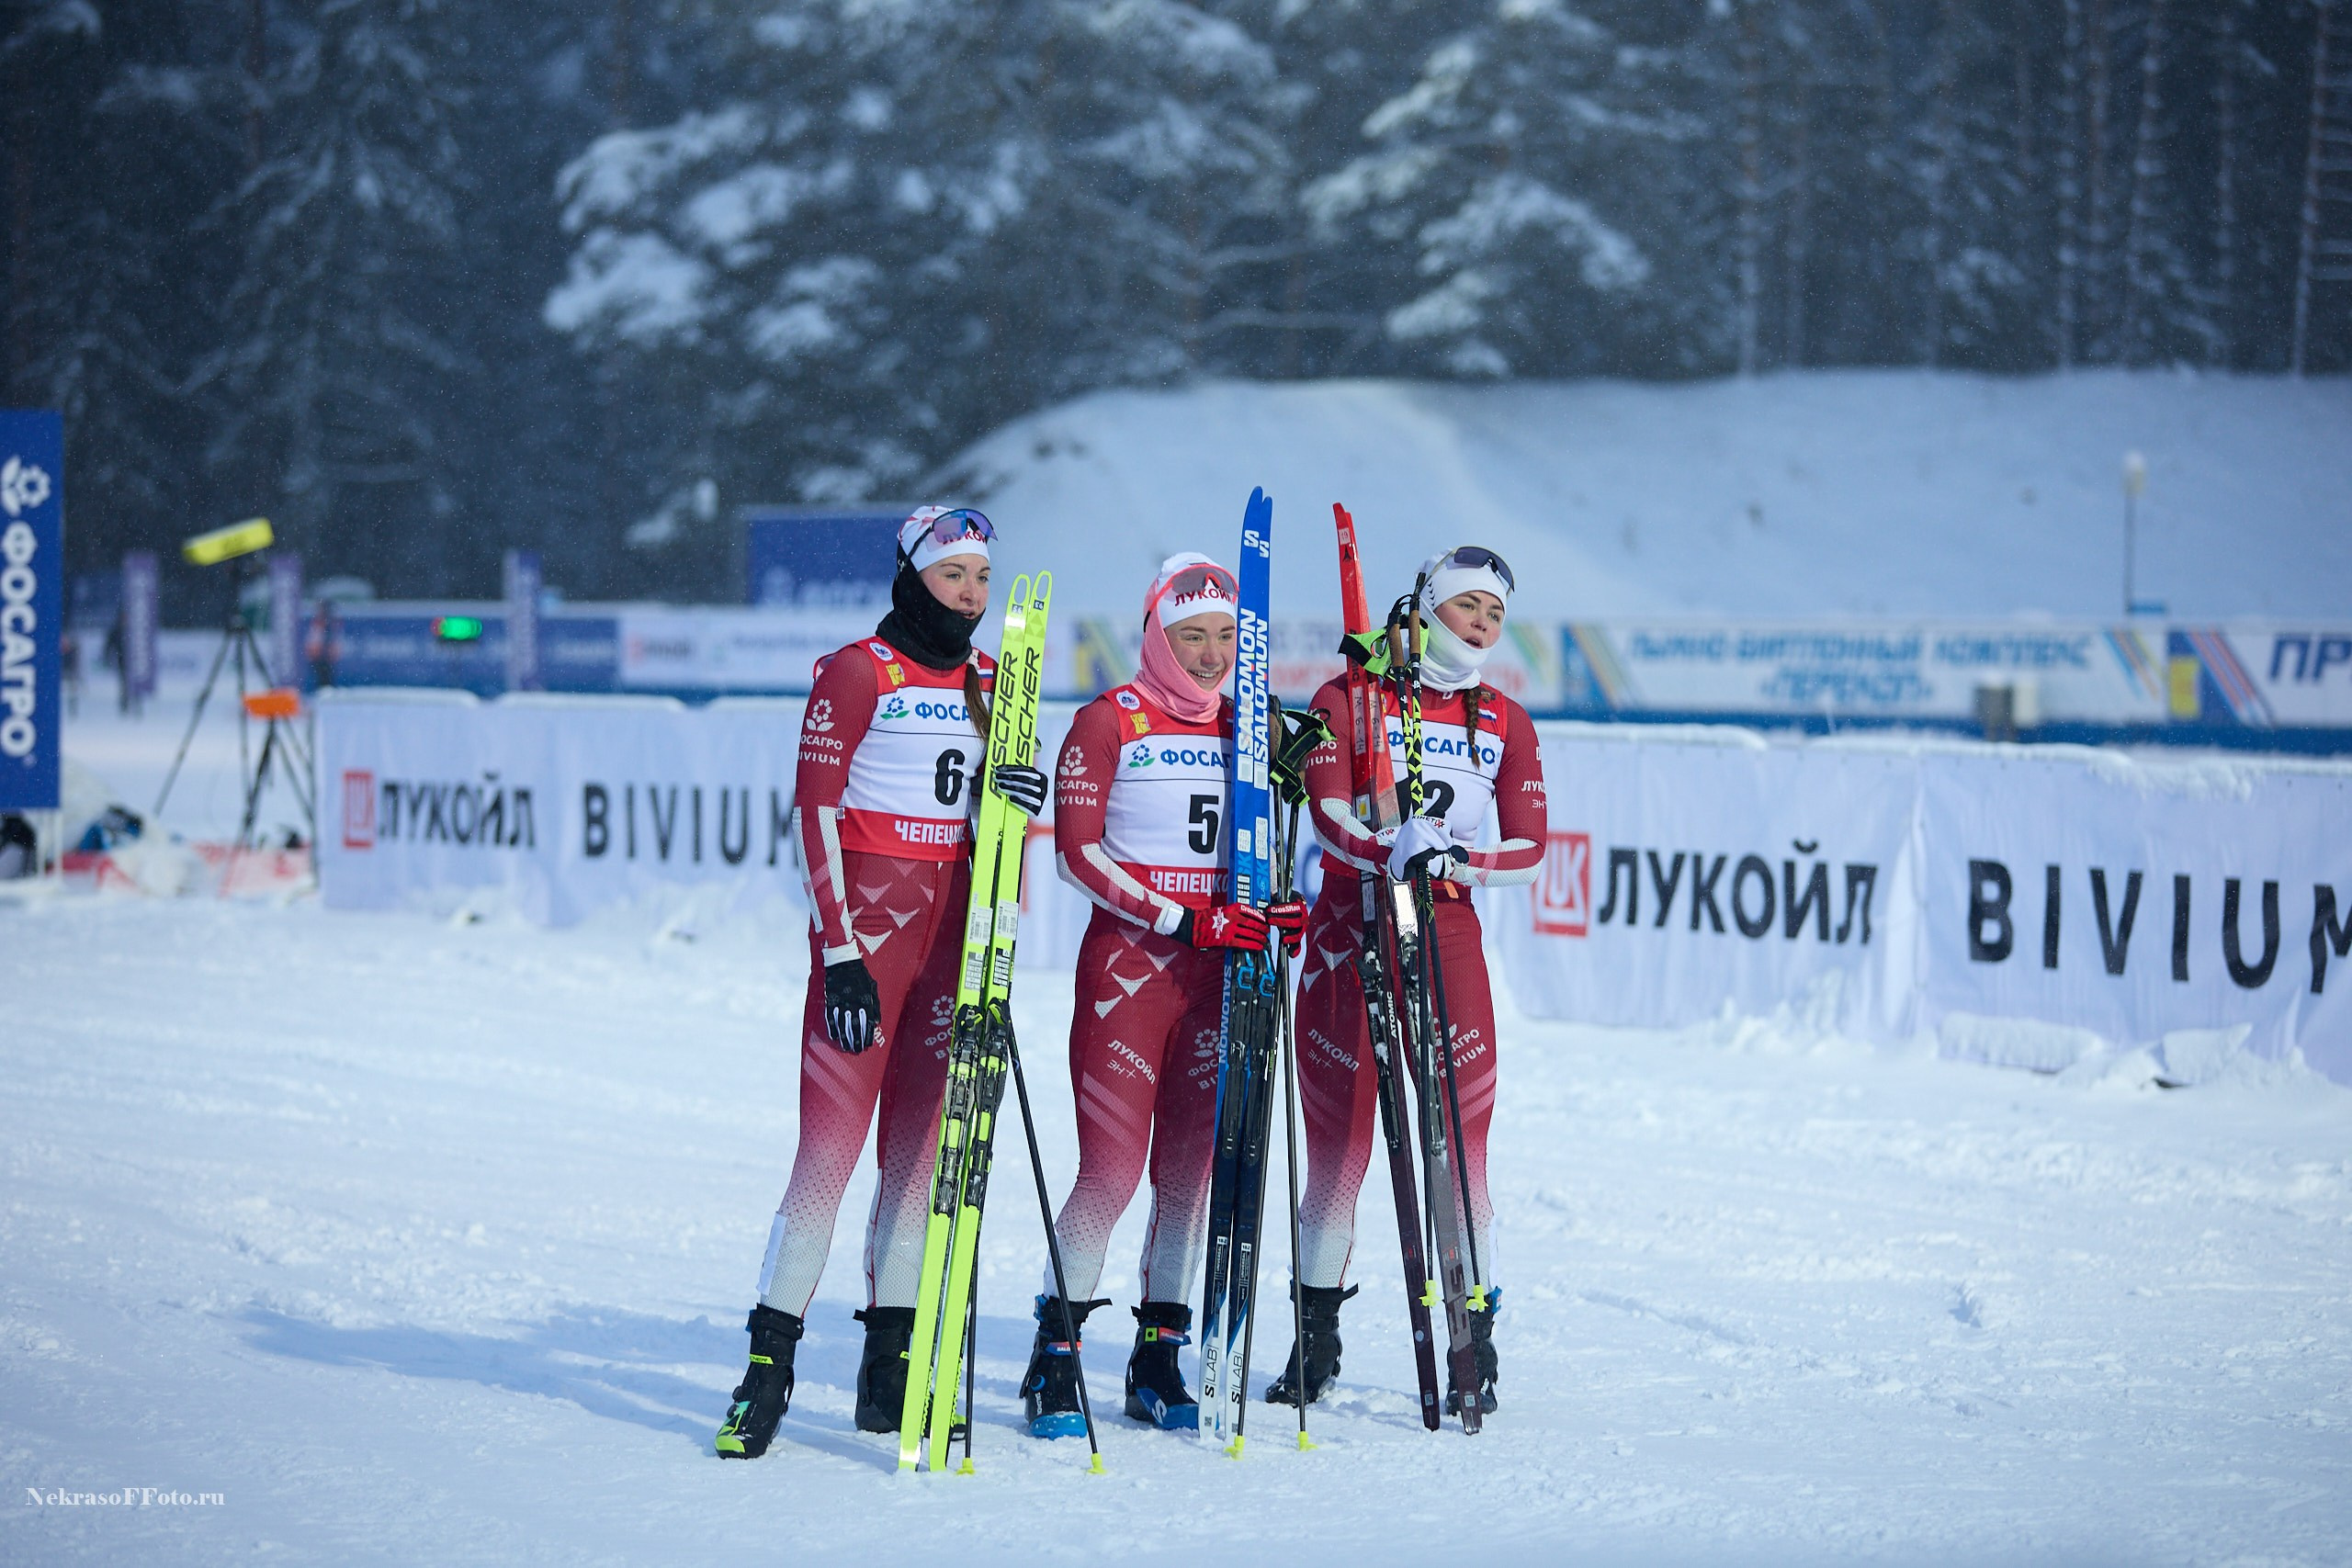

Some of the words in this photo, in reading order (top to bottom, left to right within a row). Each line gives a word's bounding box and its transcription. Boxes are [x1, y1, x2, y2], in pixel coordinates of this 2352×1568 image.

[0, 521, 38, 757] ФОСАГРО
[1238, 607, 1257, 754] SALOMON
[914, 701, 970, 722] ФОСА
[798, 750, 841, 766] IVIUM
[800, 734, 843, 751] ОСАГРО
[1160, 748, 1231, 768] ФОСАГ
[934, 748, 966, 807] 6
[1055, 795, 1098, 807] IVIUM
[1056, 779, 1099, 793] ОСАГРО
[378, 770, 538, 851] ЛУКОЙЛ
[583, 782, 800, 868] BIVIUM
[1188, 794, 1219, 854] 5
[1597, 837, 1879, 947] ЛУКОЙЛ
[1967, 856, 2352, 996] BIVIUM
[1218, 964, 1231, 1064] SALOMON
[1386, 990, 1397, 1039] ATOMIC
[1107, 1039, 1157, 1085] ЛУКОЙЛ
[1307, 1028, 1361, 1073] ЛУКОЙЛ
[1439, 1043, 1487, 1079] BVIUM
